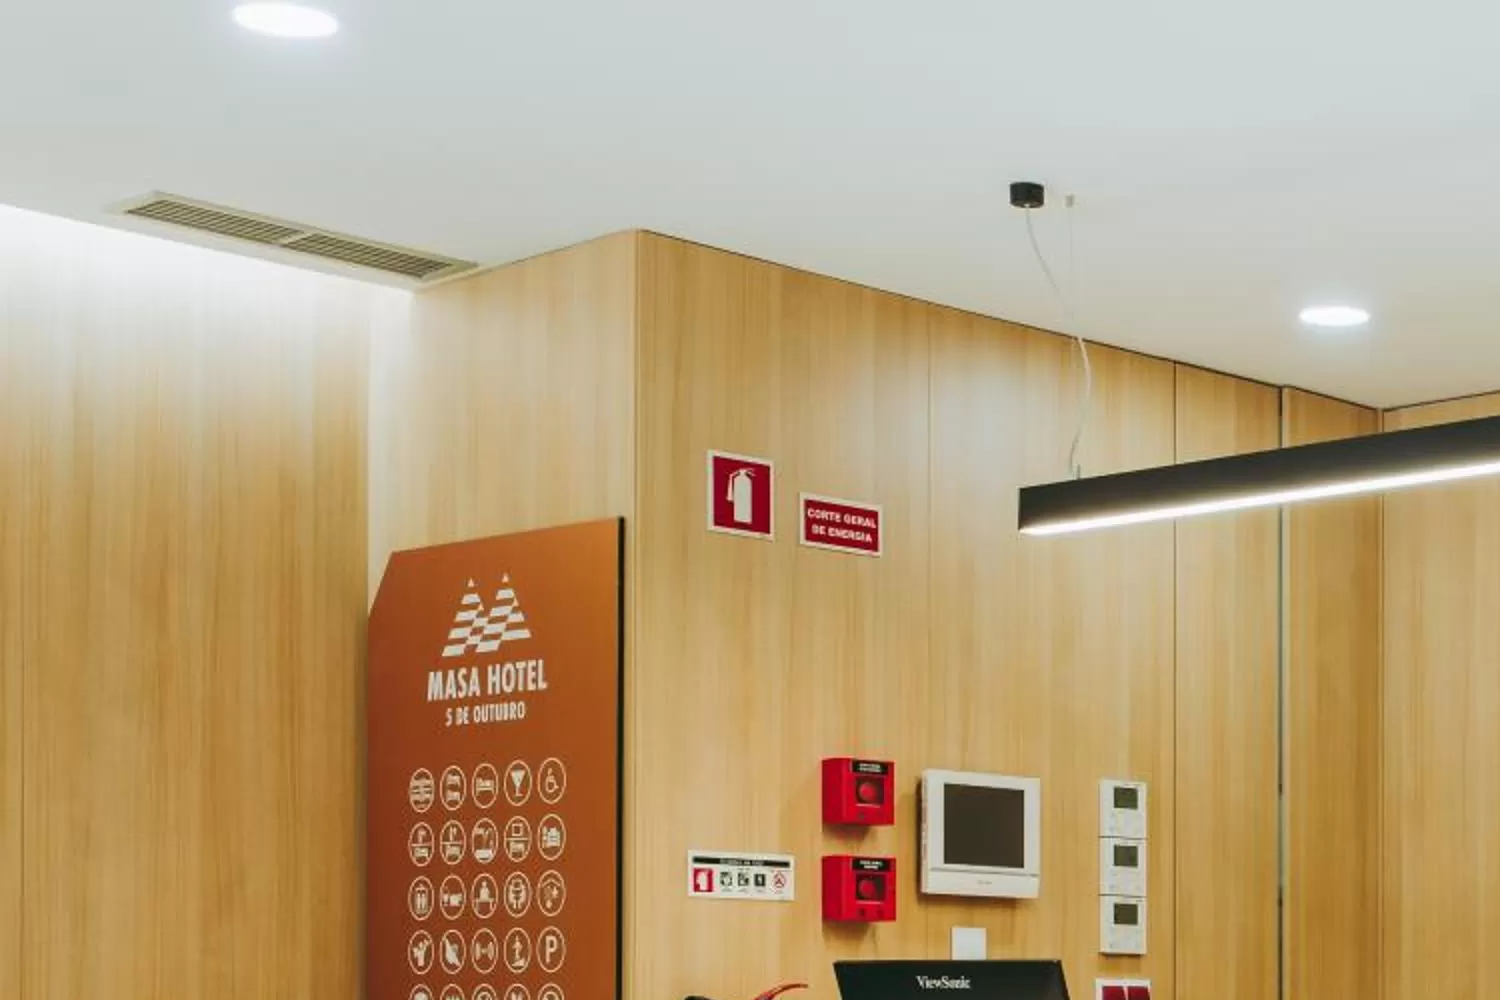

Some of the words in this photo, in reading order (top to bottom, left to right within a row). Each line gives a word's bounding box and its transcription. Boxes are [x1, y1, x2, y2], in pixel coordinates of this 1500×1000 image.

[807, 508, 841, 523] CORTE
[843, 513, 877, 529] GERAL
[811, 524, 826, 535] DE
[827, 527, 873, 543] ENERGIA
[427, 667, 480, 702] MASA
[487, 659, 548, 695] HOTEL
[445, 707, 453, 727] 5
[455, 706, 470, 726] DE
[473, 701, 526, 723] OUTUBRO
[915, 975, 971, 989] ViewSonic
